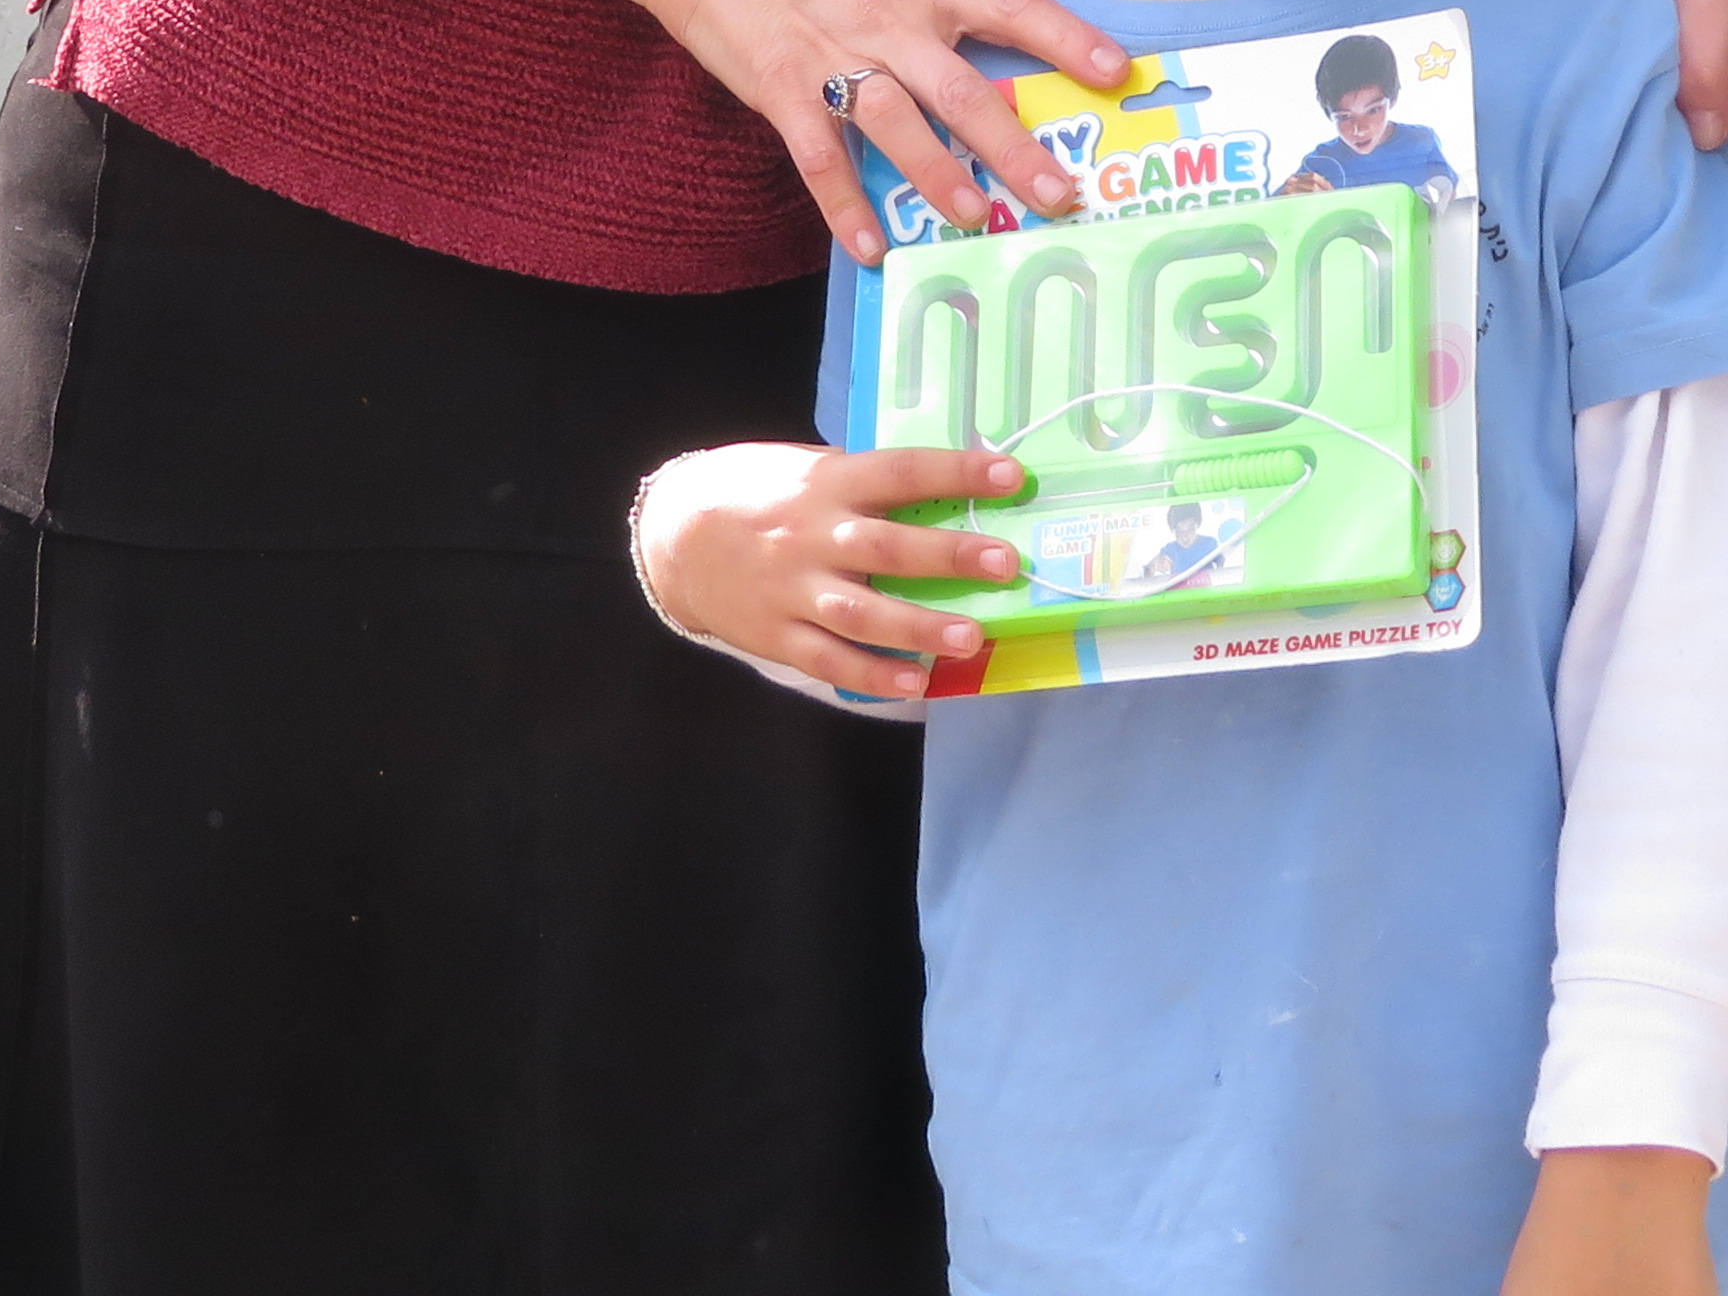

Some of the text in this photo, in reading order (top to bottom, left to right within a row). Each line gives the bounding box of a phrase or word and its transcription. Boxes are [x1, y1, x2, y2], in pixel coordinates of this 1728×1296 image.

[1098, 139, 1257, 201] GAME
[1043, 514, 1152, 539] FUNNY MAZE
[1043, 540, 1089, 557] GAME
[1193, 618, 1463, 661] 3D MAZE GAME PUZZLE TOY
